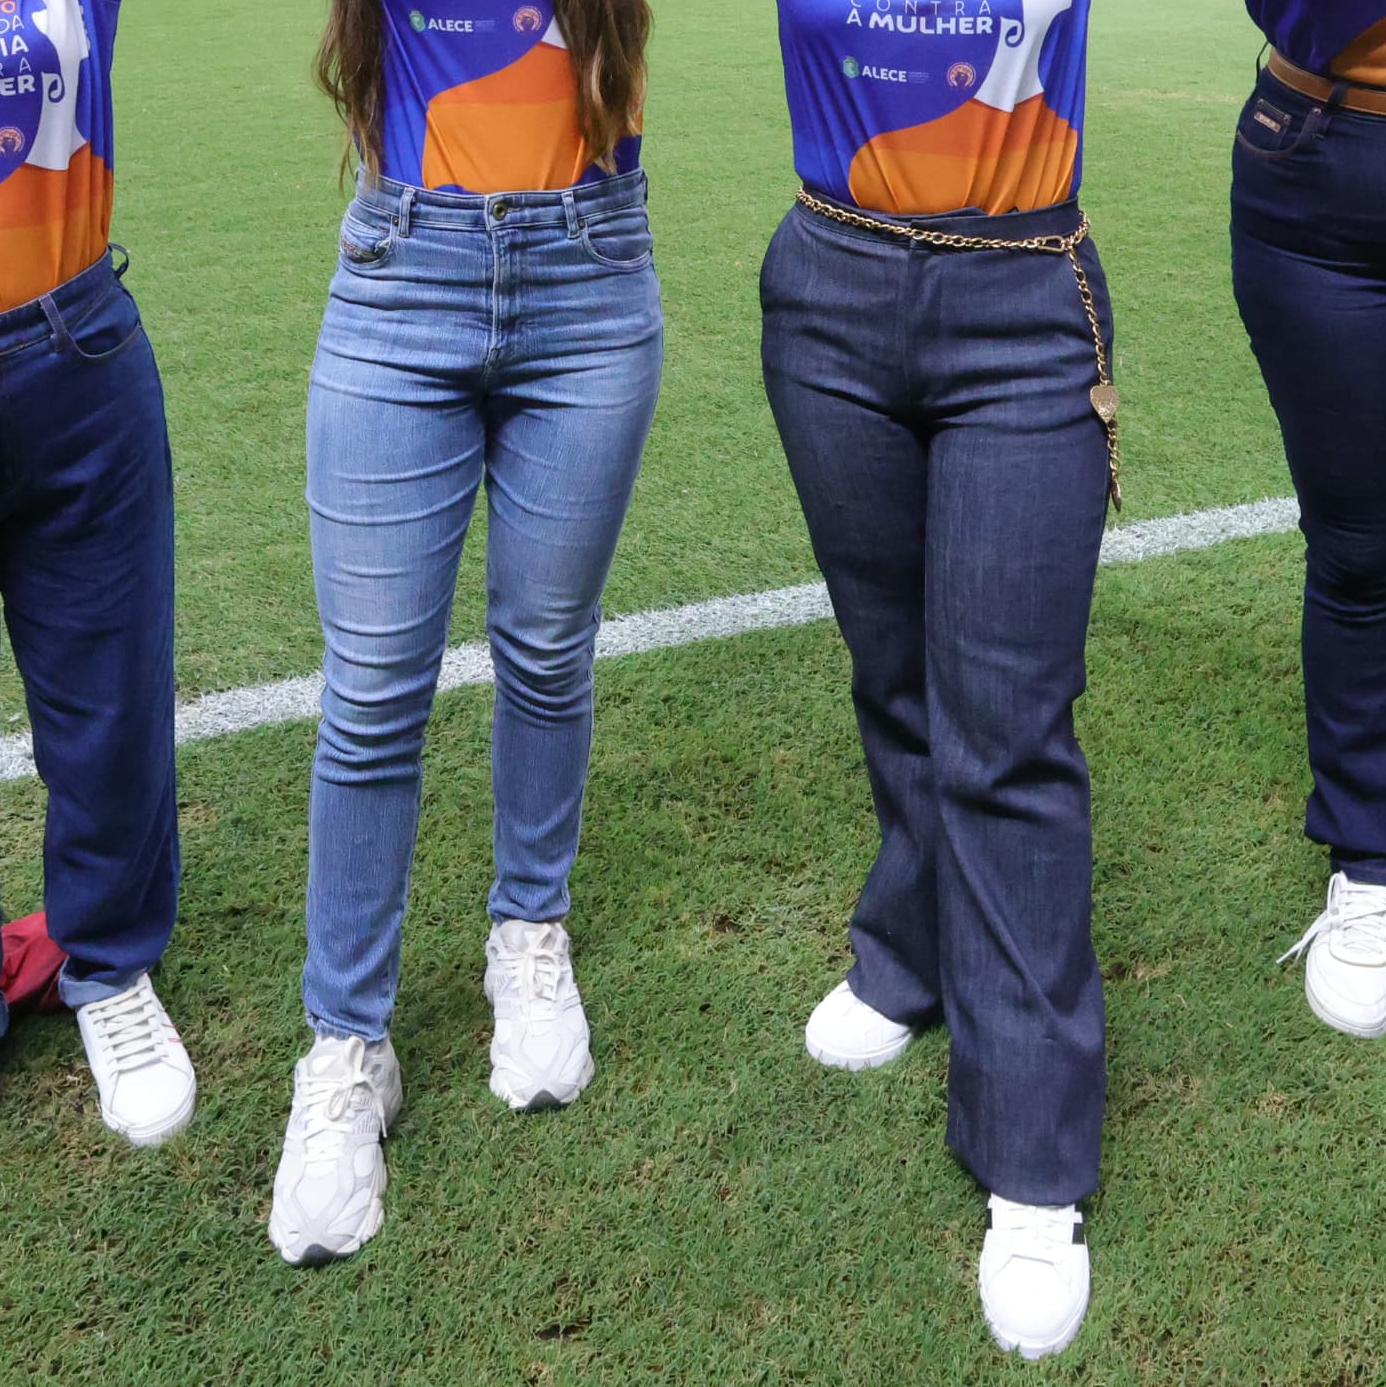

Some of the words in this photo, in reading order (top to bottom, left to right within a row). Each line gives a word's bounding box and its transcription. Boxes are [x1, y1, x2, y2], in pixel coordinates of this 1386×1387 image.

[429, 18, 474, 32] ALECE
[847, 8, 862, 27] A
[869, 13, 993, 35] MULHER
[862, 66, 907, 82] ALECE
